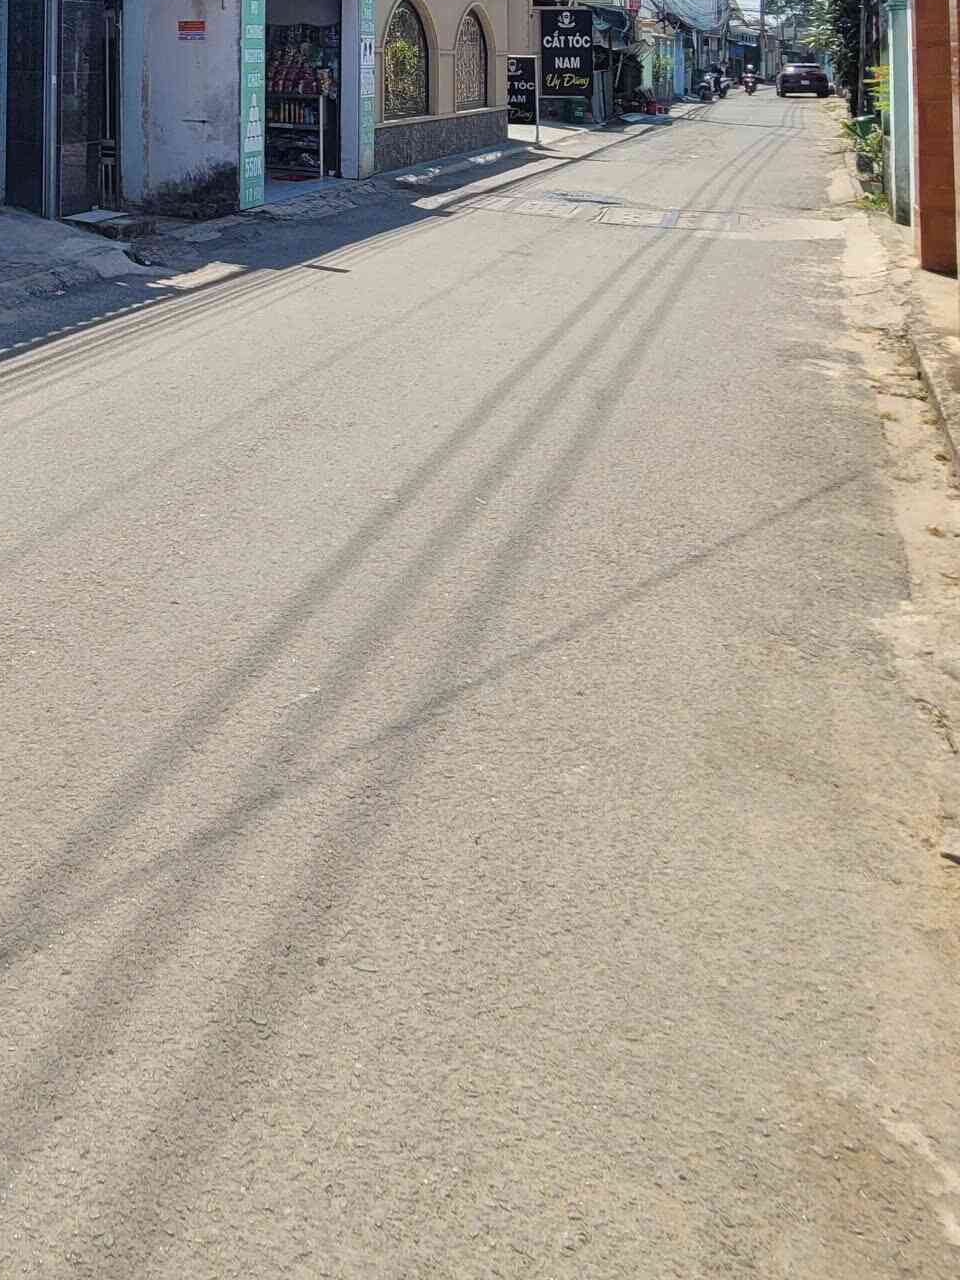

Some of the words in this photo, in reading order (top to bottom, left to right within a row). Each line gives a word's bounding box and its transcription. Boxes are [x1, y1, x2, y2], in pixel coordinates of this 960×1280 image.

[543, 30, 565, 48] CẮT
[567, 32, 591, 48] TÓC
[555, 57, 580, 69] NAM
[513, 79, 535, 90] TÓC
